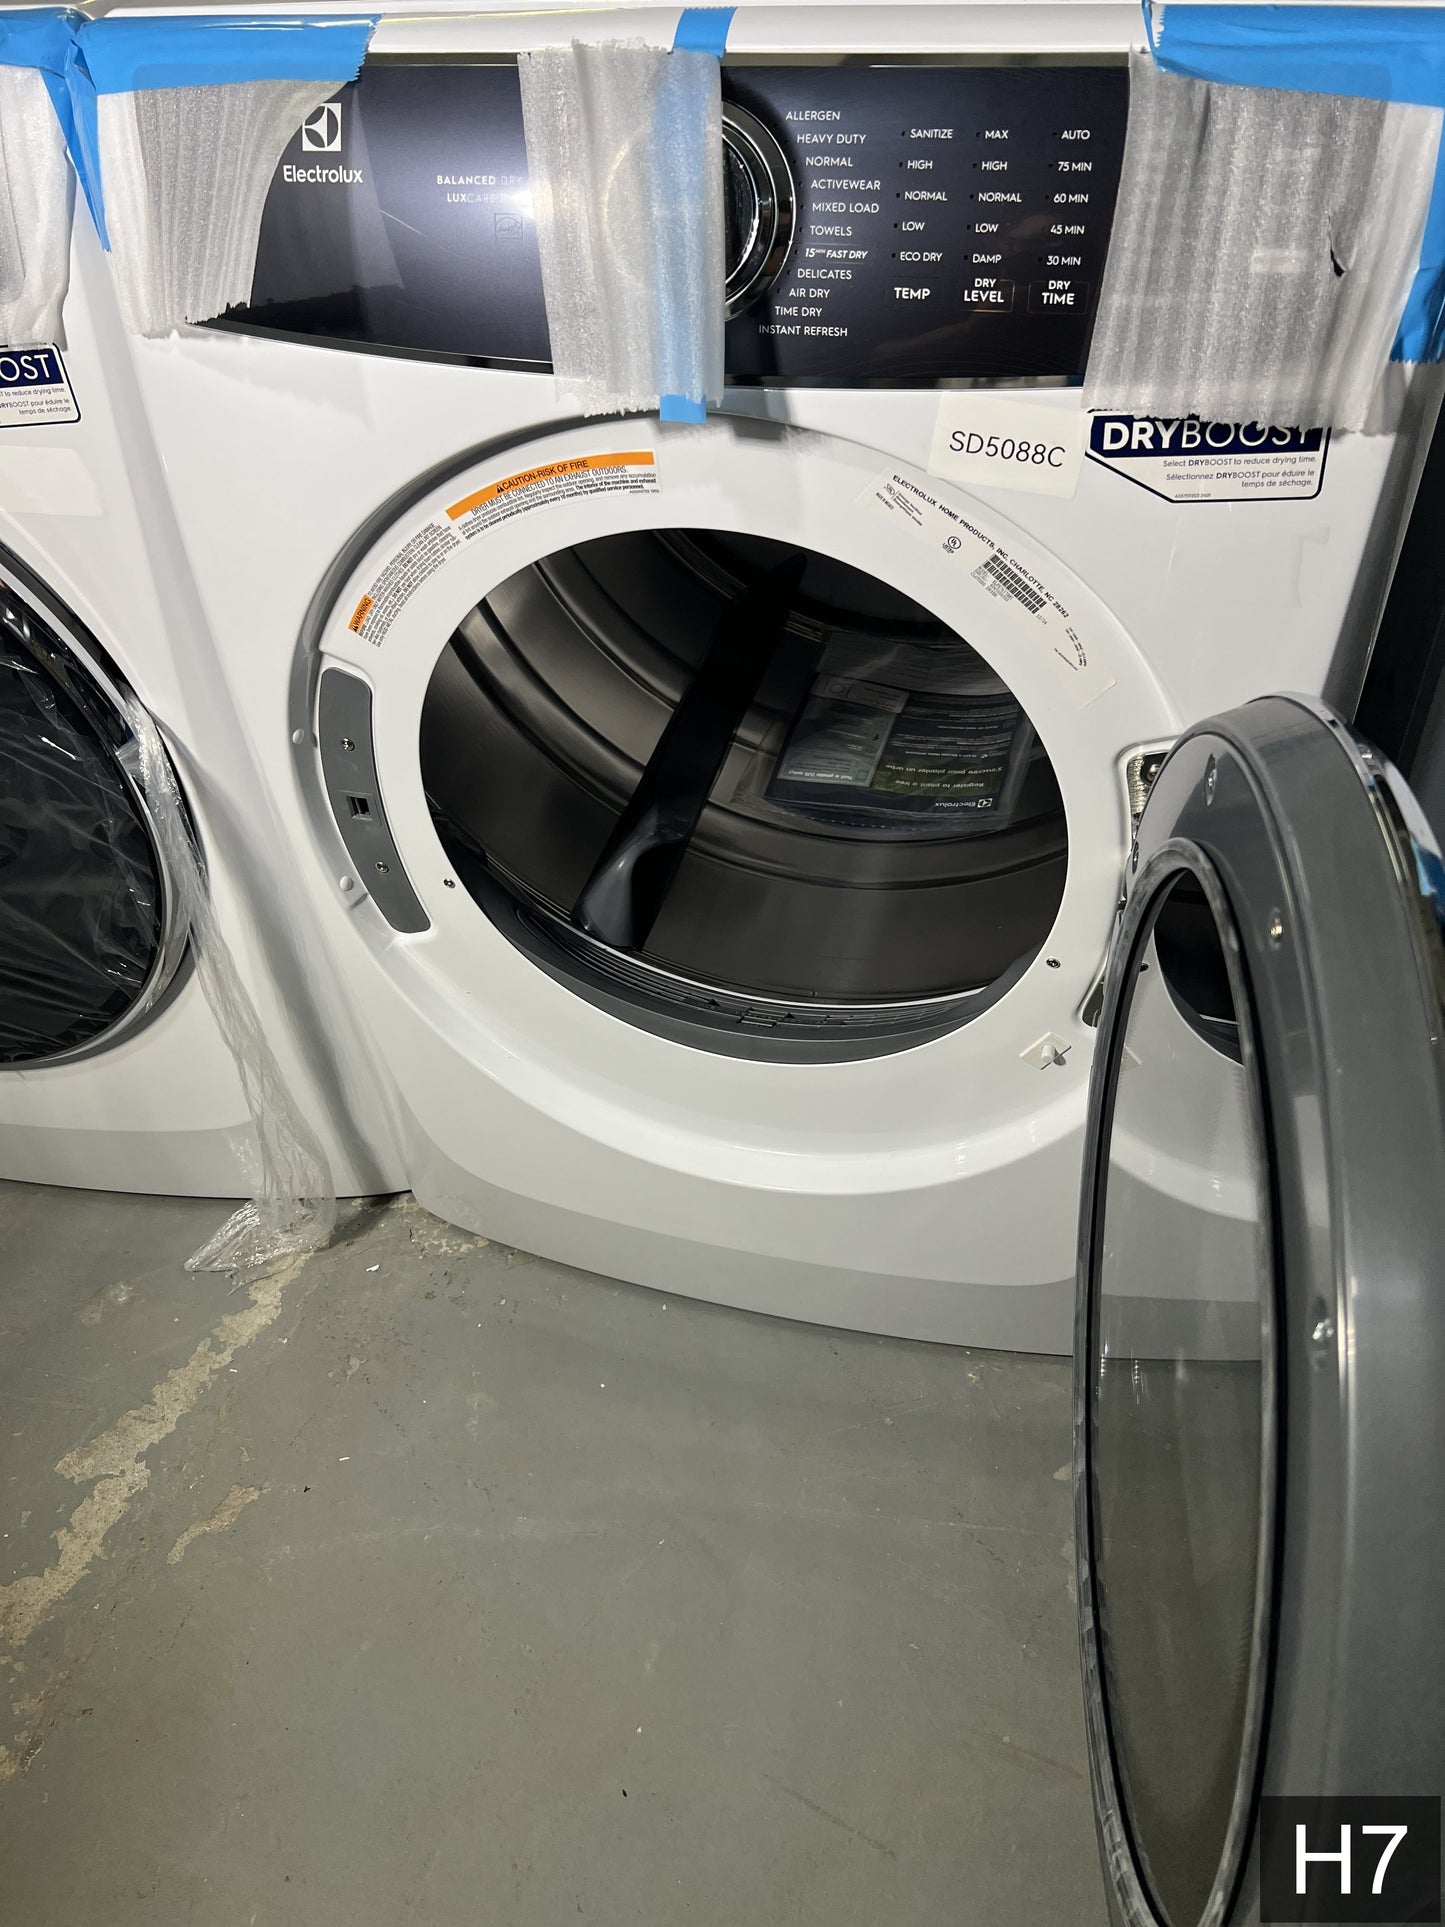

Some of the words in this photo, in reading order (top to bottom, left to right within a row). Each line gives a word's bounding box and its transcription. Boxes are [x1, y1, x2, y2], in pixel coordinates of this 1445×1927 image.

[786, 111, 840, 120] ALLERGEN
[911, 129, 953, 138] SANITIZE
[985, 130, 1008, 138] MAX
[1062, 130, 1090, 139] AUTO
[797, 134, 833, 143] HEAVY
[837, 134, 866, 144] DUTY
[806, 156, 853, 166] NORMAL
[908, 160, 932, 169] HIGH
[982, 161, 1007, 170] HIGH
[1058, 162, 1069, 171] 75
[1072, 162, 1092, 171] MIN
[283, 165, 363, 183] Electrolux
[437, 176, 495, 184] BALANCED
[811, 179, 880, 190] ACTIVEWEAR
[905, 191, 947, 201] NORMAL
[979, 192, 1021, 202] NORMAL
[1054, 193, 1066, 203] 60
[1069, 194, 1088, 202] MIN
[813, 203, 846, 212] MIXED
[850, 203, 879, 213] LOAD
[810, 226, 852, 236] TOWELS
[903, 222, 925, 230] LOW
[976, 223, 998, 232] LOW
[1051, 225, 1062, 234] 45
[1065, 226, 1084, 234] MIN
[826, 250, 848, 258] FAST
[848, 251, 868, 259] DRY
[900, 252, 920, 261] ECO
[923, 252, 942, 261] DRY
[973, 254, 1001, 263] DAMP
[1047, 256, 1059, 265] 30
[1061, 257, 1081, 265] MIN
[798, 269, 851, 279] DELICATES
[975, 278, 996, 287] DRY
[1049, 281, 1070, 289] DRY
[789, 288, 805, 297] AIR
[810, 289, 830, 298] DRY
[894, 288, 930, 299] TEMP
[964, 290, 1004, 302] LEVEL
[1042, 293, 1074, 304] TIME
[775, 306, 798, 316] TIME
[802, 307, 822, 316] DRY
[760, 325, 801, 334] INSTANT
[804, 326, 847, 336] REFRESH
[949, 430, 1065, 467] SD5088C
[557, 463, 568, 472] OF
[570, 460, 588, 469] FIRE
[1188, 458, 1232, 466] DRYBOOST
[1273, 456, 1296, 465] drying
[1216, 471, 1260, 479] DRYBOOST
[471, 502, 488, 515] DRYER
[488, 495, 504, 507] MUST
[512, 480, 545, 497] CONNECTED
[564, 470, 590, 480] EXHAUST
[892, 474, 938, 507] ELECTROLUX
[939, 504, 959, 521] HOME
[1044, 592, 1054, 602] NC
[352, 597, 371, 625] WARNING
